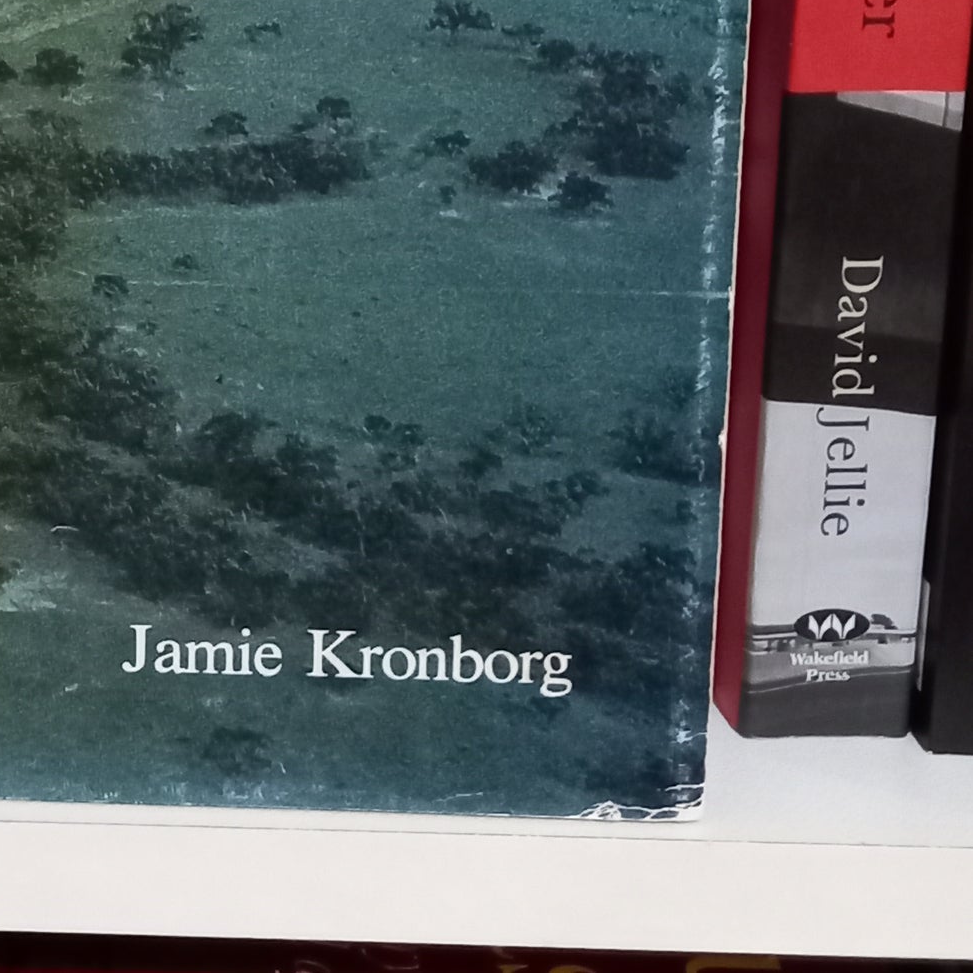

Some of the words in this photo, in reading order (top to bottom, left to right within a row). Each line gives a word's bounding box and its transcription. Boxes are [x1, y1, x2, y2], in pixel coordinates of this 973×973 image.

[831, 255, 884, 399] David
[816, 406, 871, 537] Jellie
[121, 624, 283, 677] Jamie
[306, 628, 573, 698] Kronborg
[789, 649, 869, 667] Wakefield
[806, 668, 851, 683] Press
